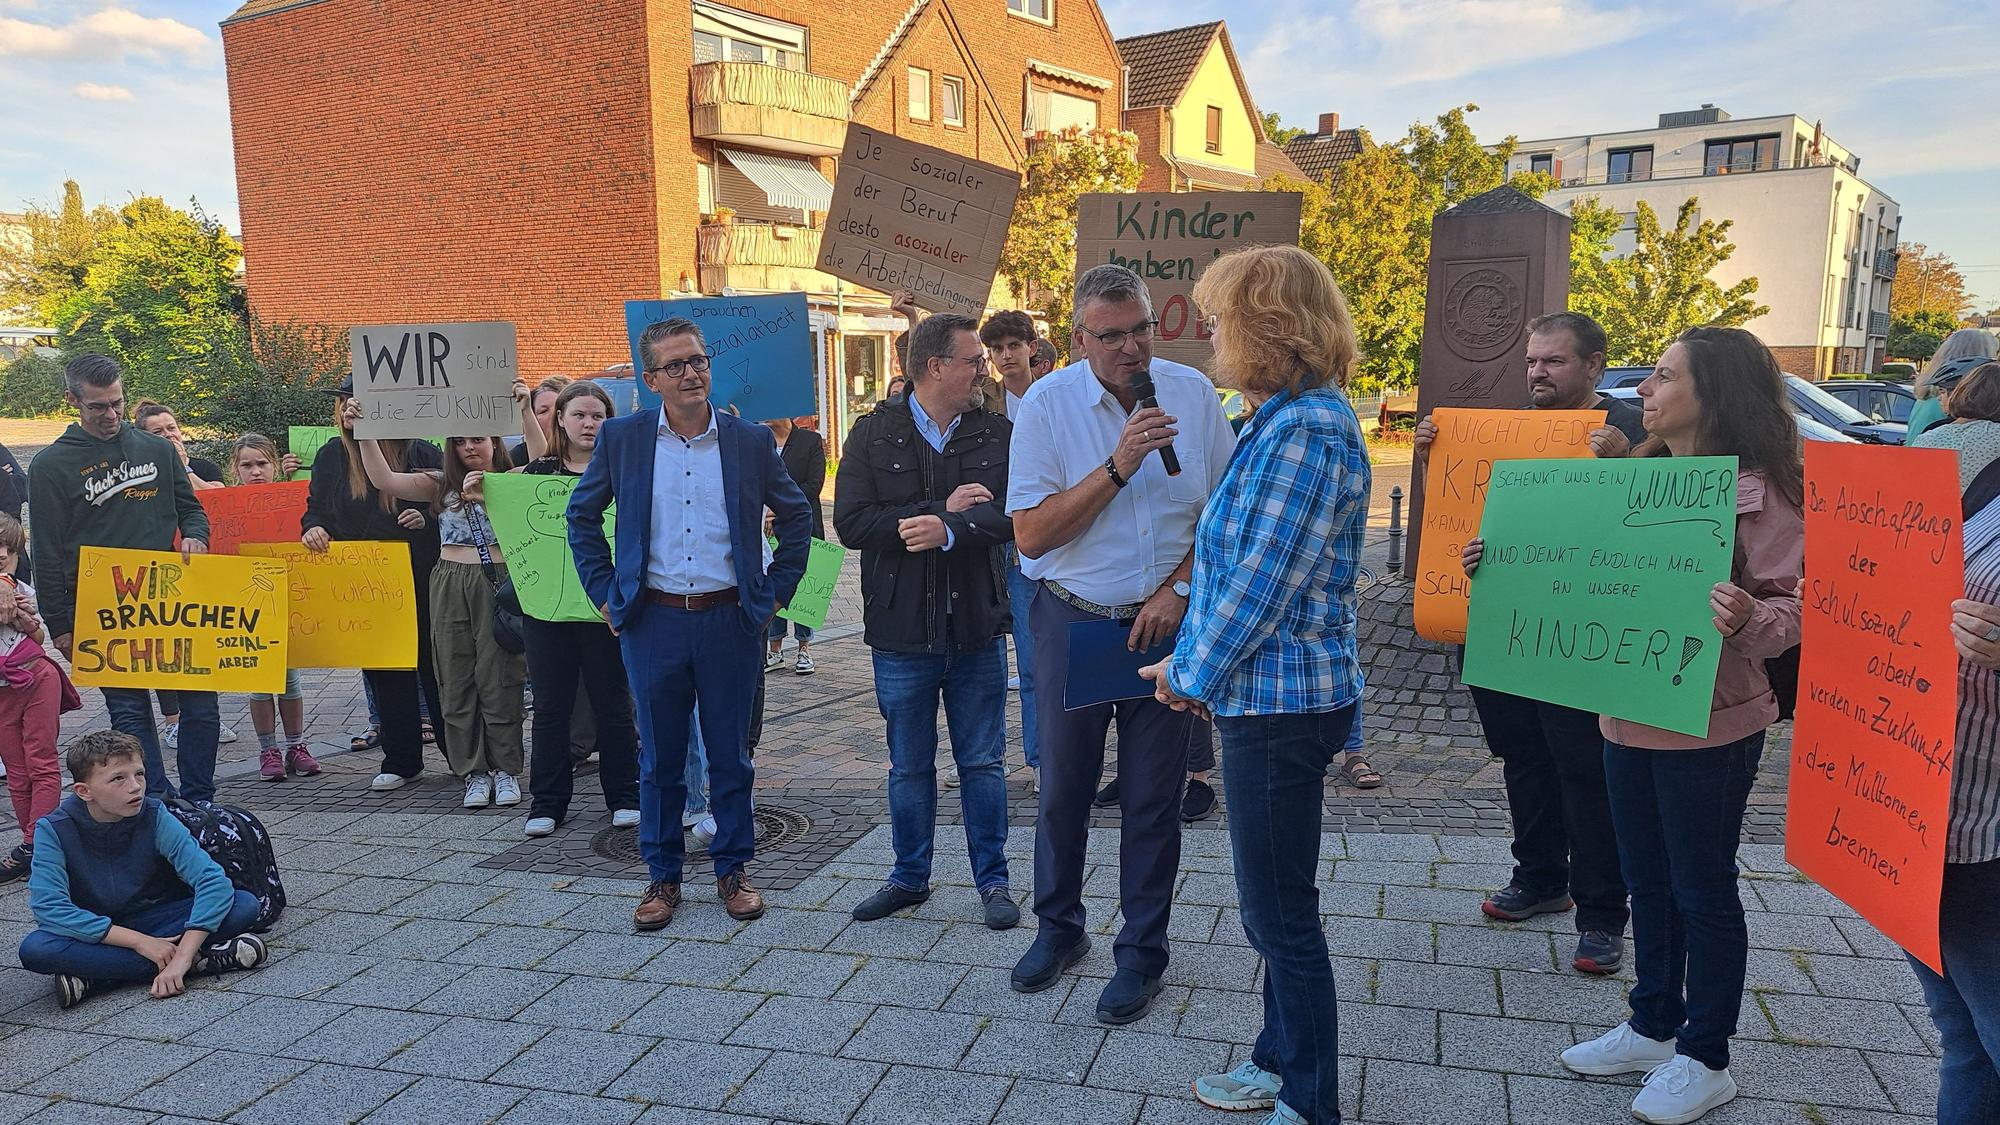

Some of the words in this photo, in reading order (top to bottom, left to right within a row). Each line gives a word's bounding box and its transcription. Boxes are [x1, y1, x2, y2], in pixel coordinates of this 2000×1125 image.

[856, 132, 882, 161] Je
[910, 157, 984, 191] sozialer
[853, 175, 881, 200] der
[900, 186, 966, 225] Beruf
[1116, 200, 1256, 241] Kinder
[838, 207, 880, 239] desto
[894, 232, 969, 265] asozialer
[824, 241, 844, 269] die
[855, 249, 985, 314] Arbeitsbedingungen
[644, 304, 677, 323] Wir
[690, 301, 757, 318] brauchen
[705, 306, 797, 359] ozialarbeit
[363, 331, 451, 388] WIR
[466, 345, 511, 370] sind
[370, 401, 405, 421] die
[414, 394, 517, 425] ZUKUNFT
[1450, 415, 1530, 446] NICHT
[85, 471, 115, 501] Jack
[119, 460, 157, 482] Jones
[1442, 454, 1492, 504] KR
[1495, 468, 1560, 489] SCHENKT
[1564, 470, 1591, 486] UNS
[1599, 470, 1627, 485] EIN
[1627, 467, 1734, 510] WUNDER
[1426, 513, 1473, 534] KANN
[1834, 485, 1952, 565] Abschaffung
[1483, 546, 1519, 566] UND
[1523, 544, 1580, 565] DENKT
[1589, 548, 1659, 570] ENDLICH
[1668, 555, 1705, 573] MAL
[1419, 571, 1470, 599] SCHU
[1552, 579, 1572, 595] AN
[1588, 581, 1641, 598] UNSERE
[96, 602, 261, 633] BRAUCHEN
[338, 617, 373, 635] uns
[77, 638, 211, 675] SCHUL
[1508, 608, 1704, 687] KINDER!
[1810, 681, 1851, 717] werden
[1854, 704, 1867, 724] in
